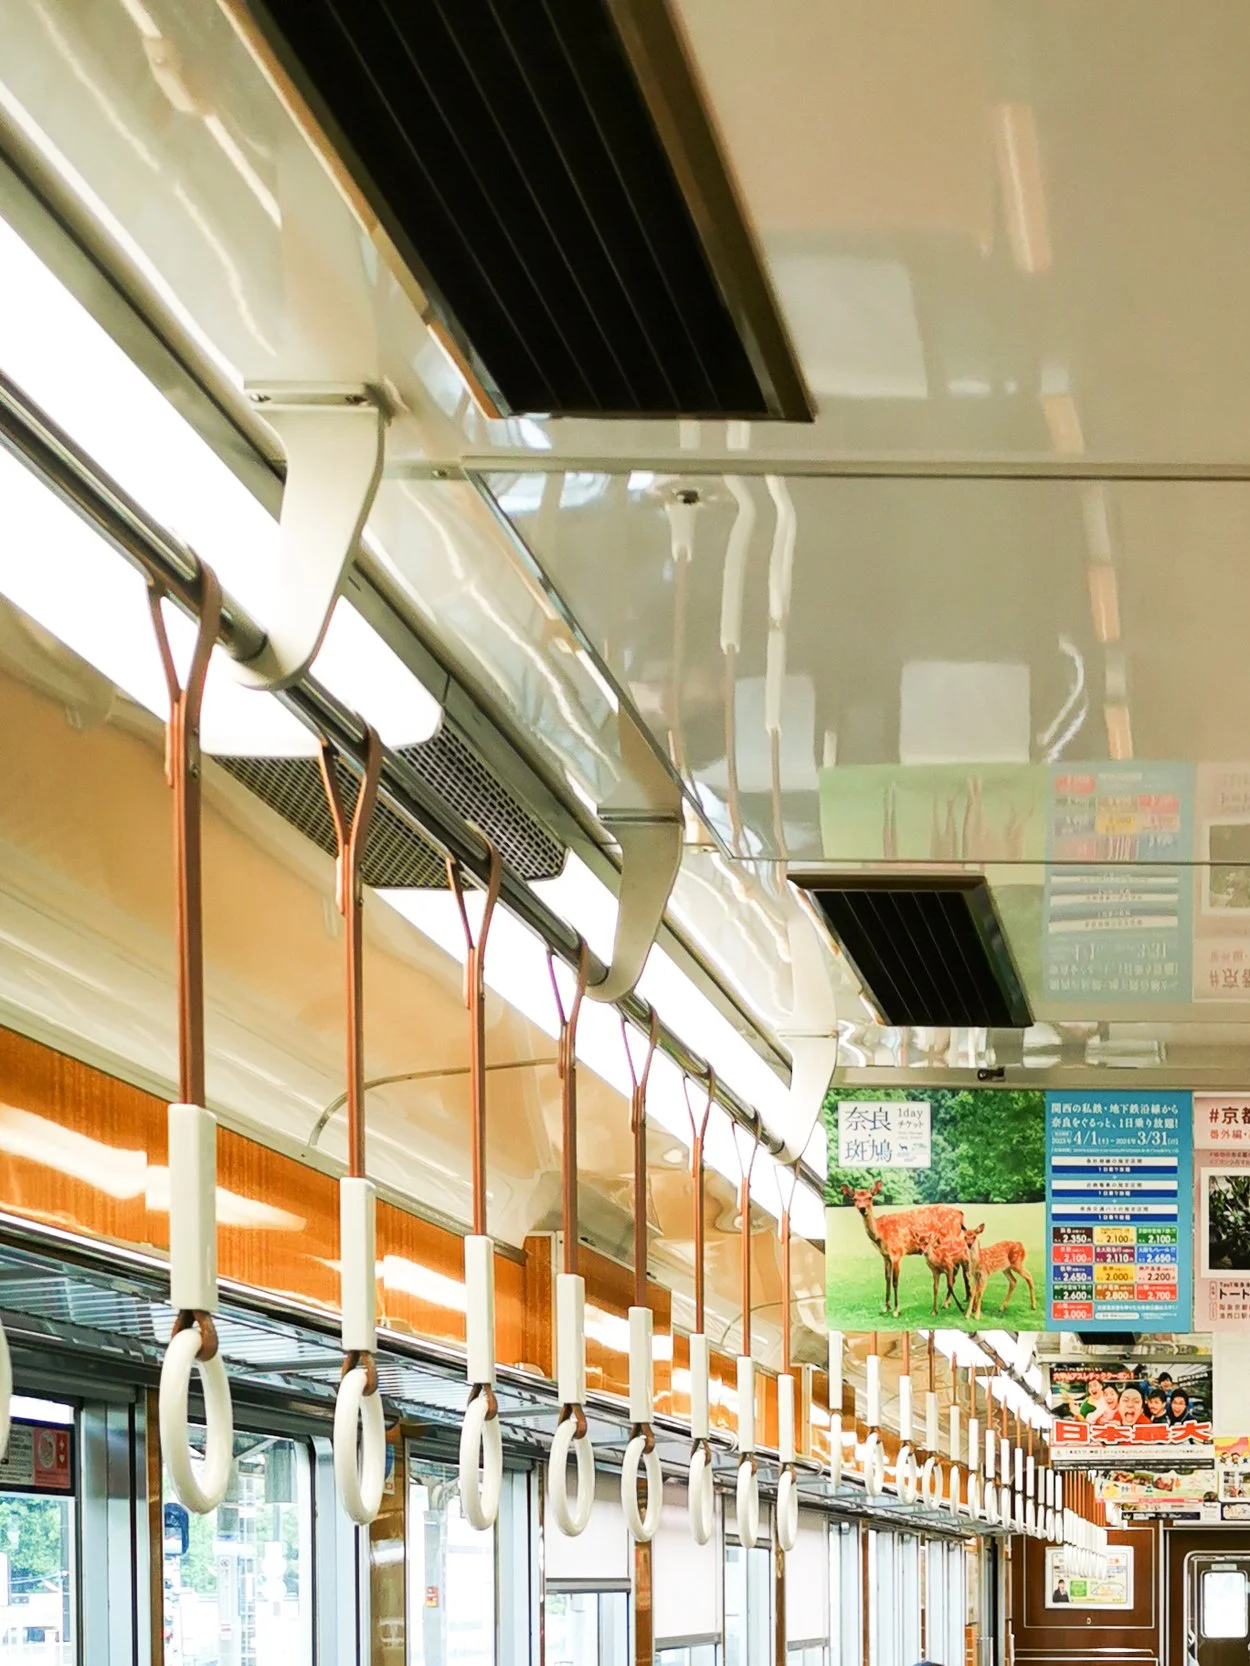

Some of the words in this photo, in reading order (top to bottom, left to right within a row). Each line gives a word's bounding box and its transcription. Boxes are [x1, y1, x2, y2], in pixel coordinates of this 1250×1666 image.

[844, 1107, 892, 1131] 奈良
[898, 1108, 924, 1119] 1day
[898, 1121, 924, 1129] チケット
[845, 1139, 893, 1163] 斑鳩
[1054, 1420, 1212, 1443] 日本最大
